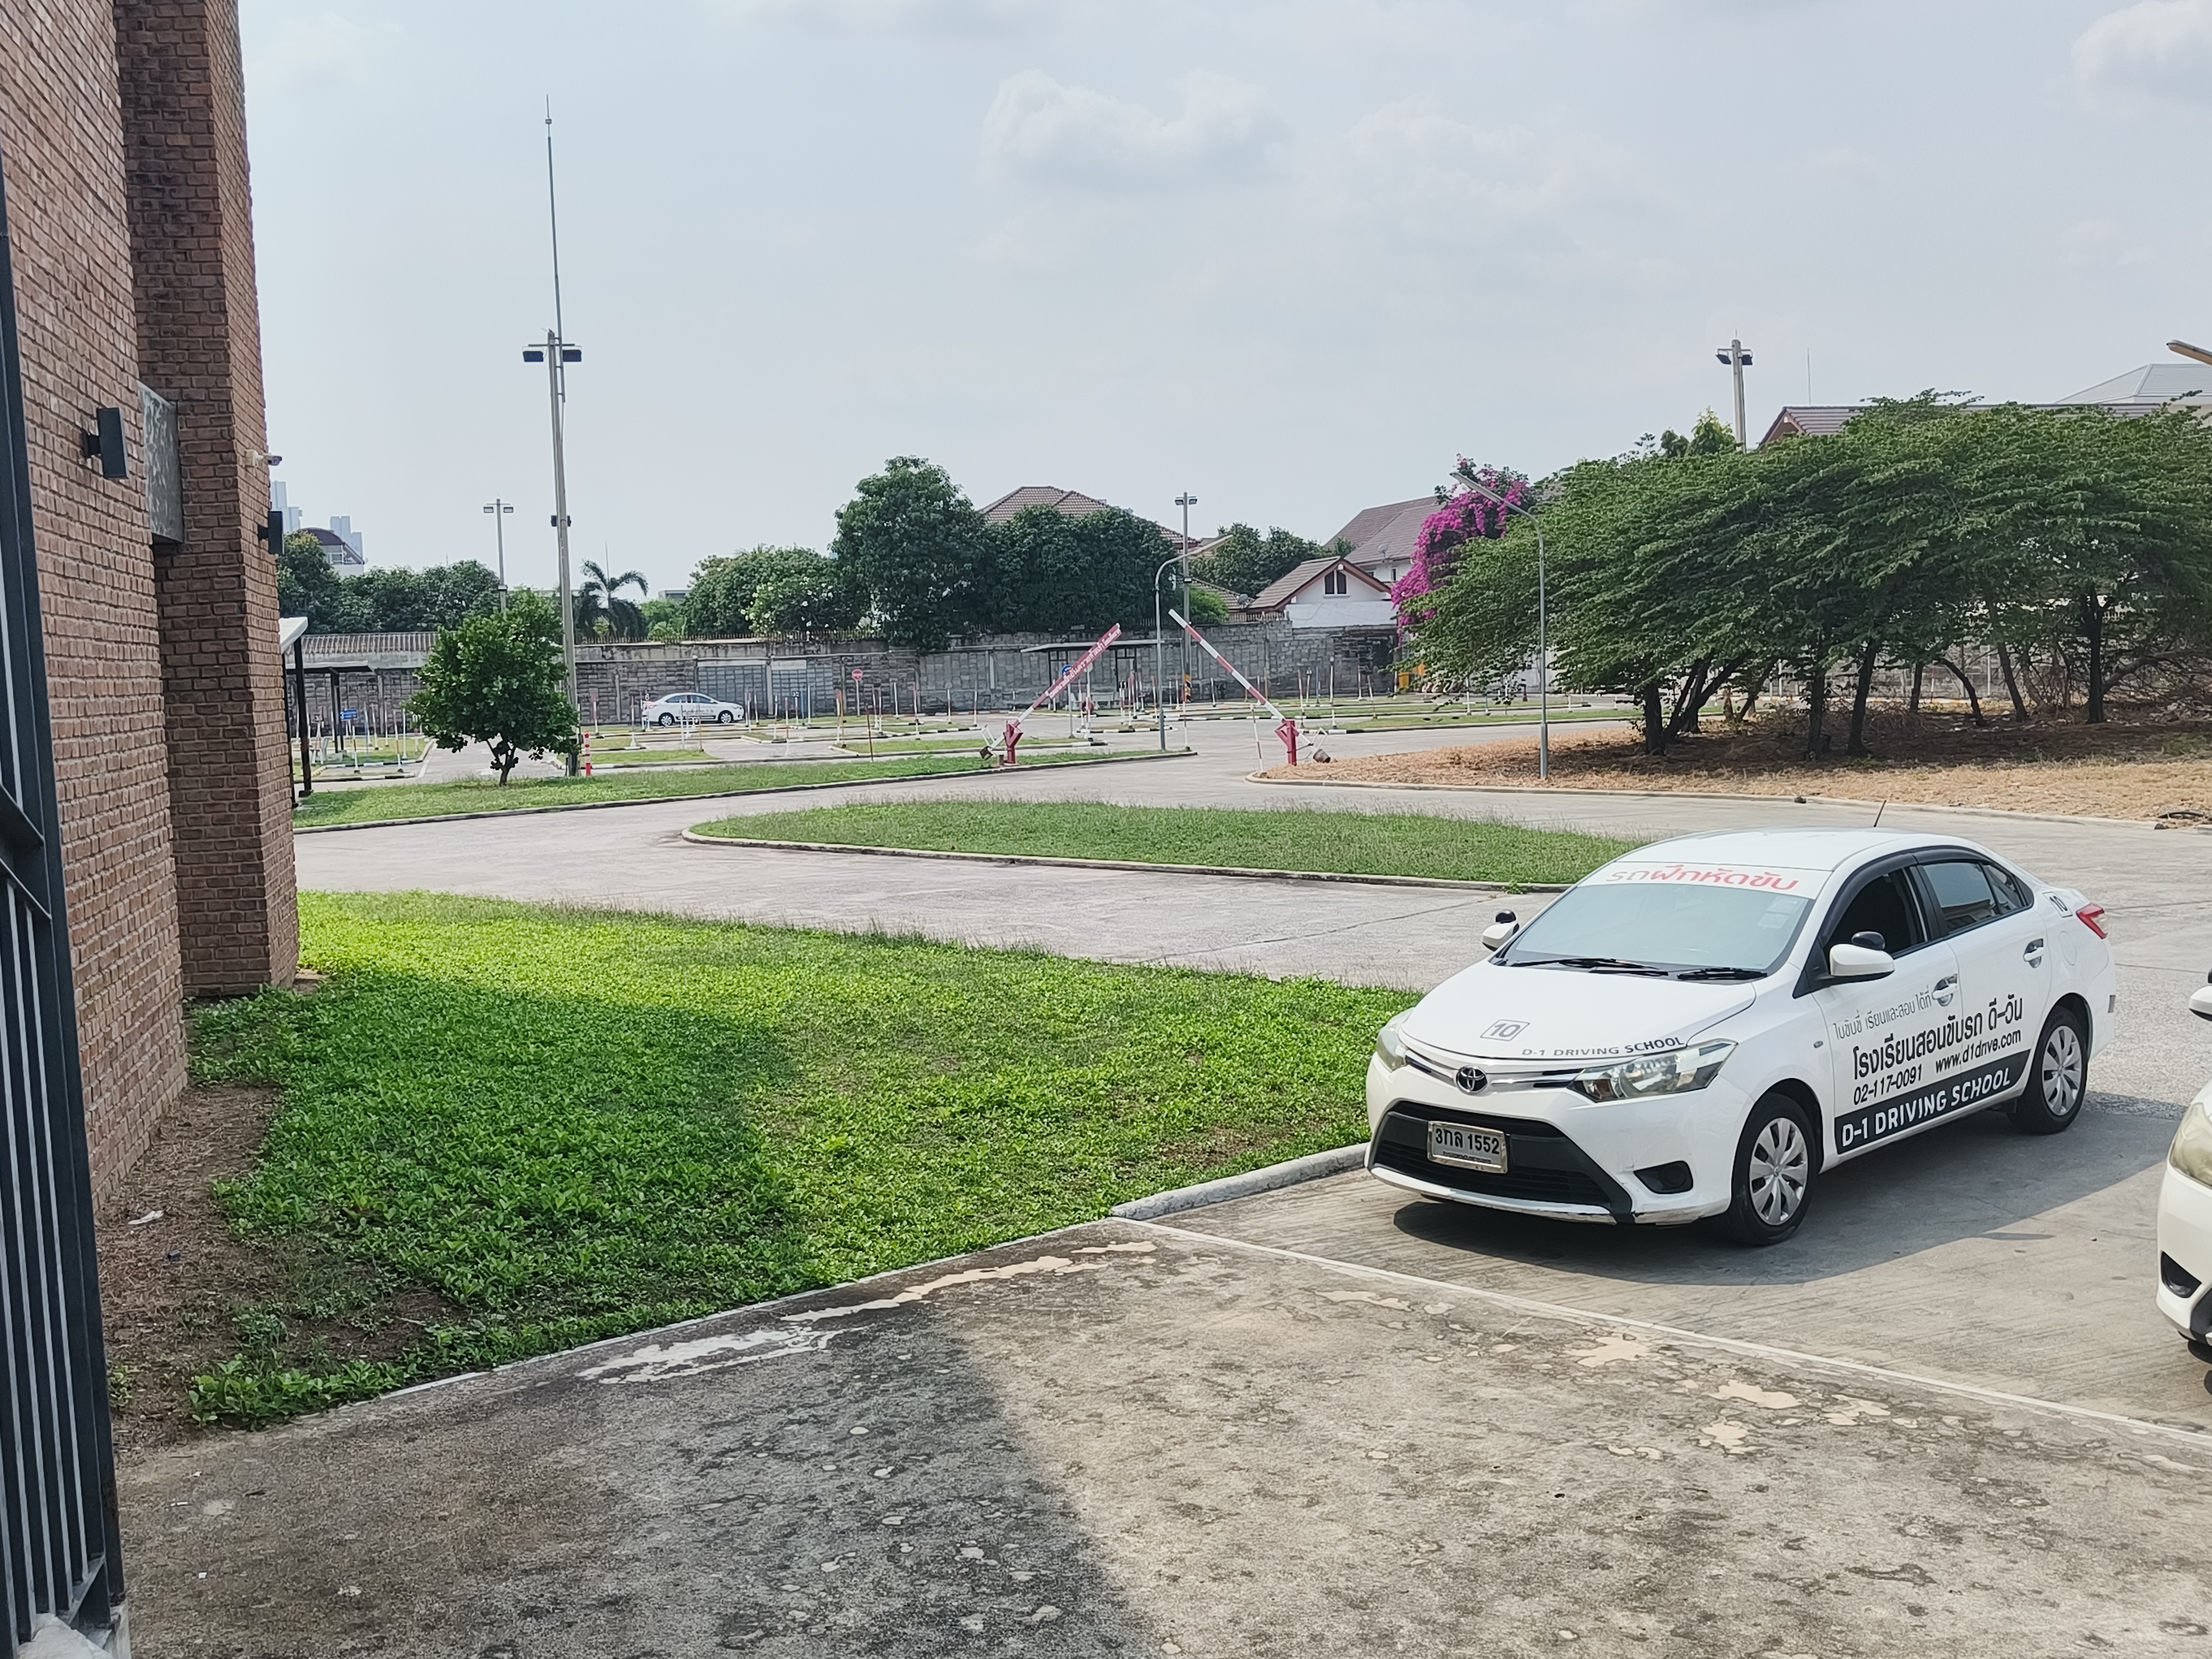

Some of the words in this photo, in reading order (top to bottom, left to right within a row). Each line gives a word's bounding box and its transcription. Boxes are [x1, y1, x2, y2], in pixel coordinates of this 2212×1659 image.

[1606, 864, 1799, 890] รถฝึกหัดขับ
[2049, 895, 2068, 912] 10
[1489, 1022, 1521, 1038] 10
[1852, 1012, 1983, 1080] โรงเรียนสอนขับรถ
[1988, 994, 2022, 1031] ดี-วัน
[1553, 1046, 1620, 1056] DRIVING
[1624, 1036, 1685, 1054] SCHOOL
[1934, 1029, 2021, 1074] www.d1drive.com
[1853, 1063, 1923, 1105] 02-117-0091
[1842, 1117, 1868, 1147] D-1
[1874, 1090, 1947, 1135] DRIVING
[1951, 1067, 2011, 1107] SCHOOL
[1435, 1128, 1464, 1148] 3กล
[1467, 1134, 1500, 1155] 1552
